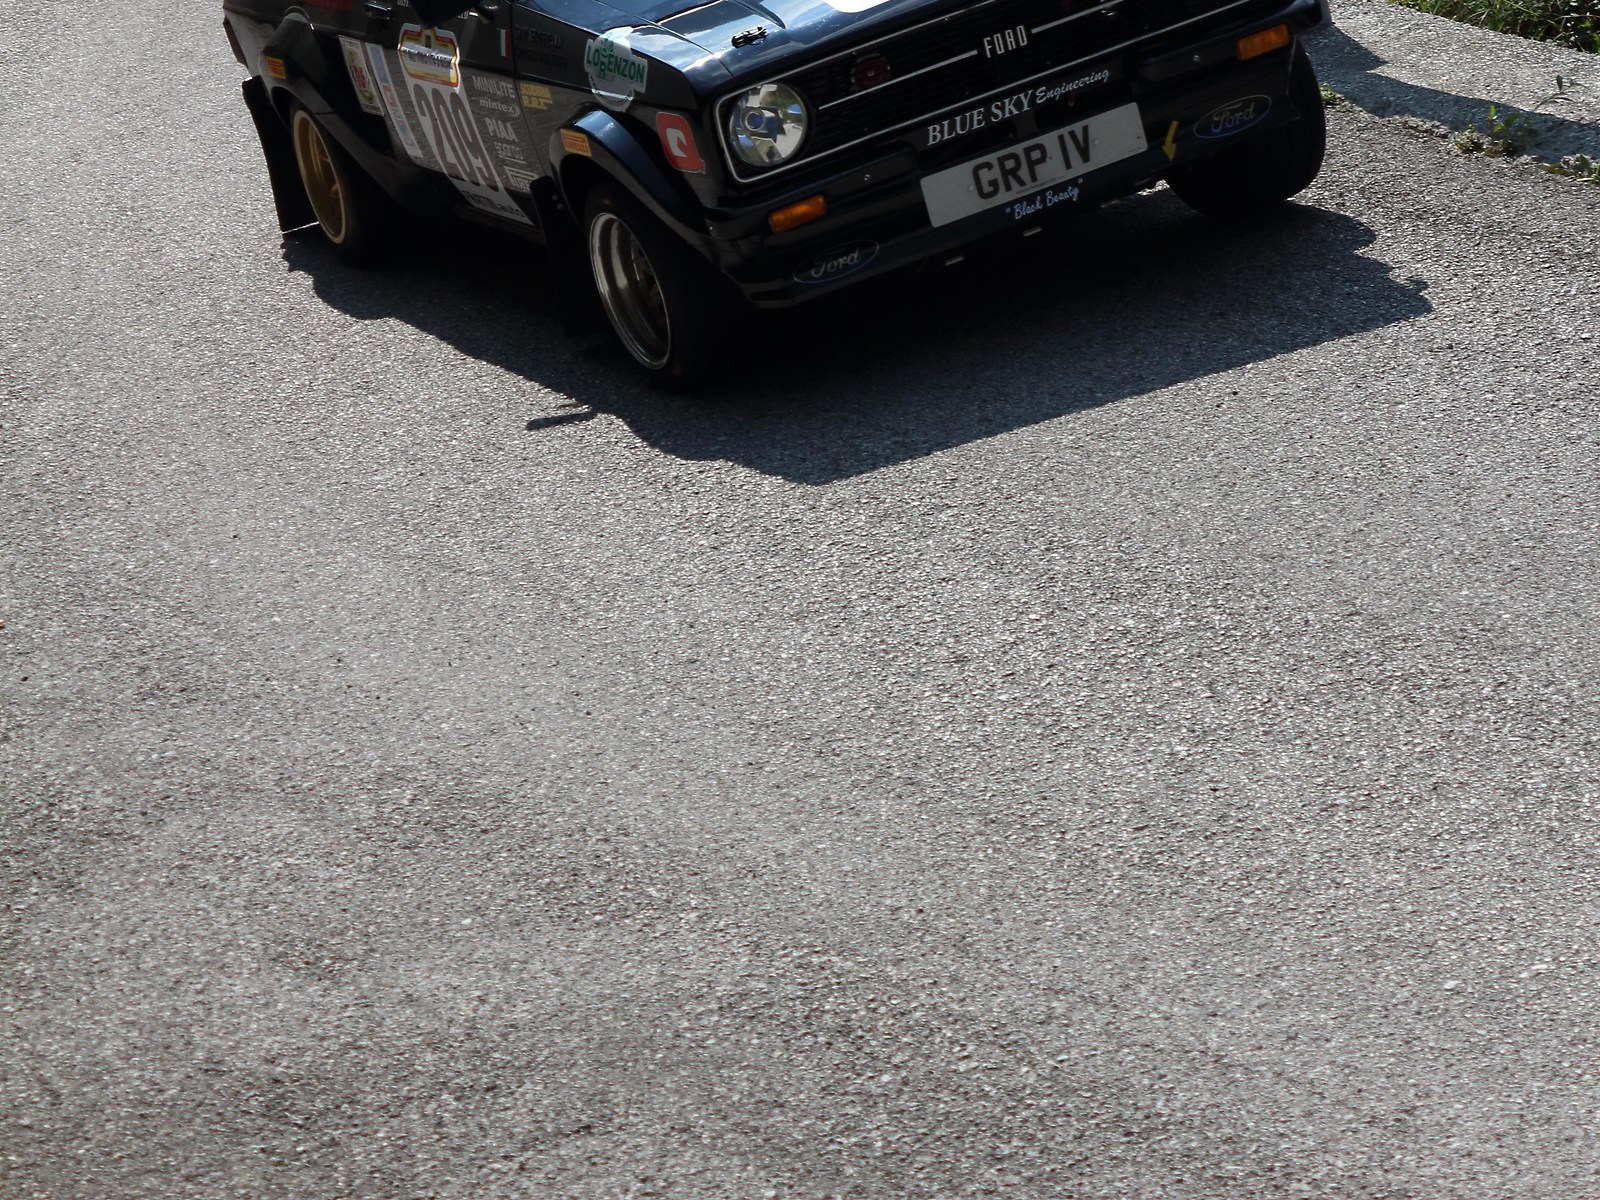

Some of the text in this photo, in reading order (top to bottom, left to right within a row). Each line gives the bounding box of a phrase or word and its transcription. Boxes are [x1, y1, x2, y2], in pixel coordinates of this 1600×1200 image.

[983, 26, 1028, 58] FORD
[926, 69, 1110, 147] BLUE SKY Engineering
[1210, 102, 1256, 132] Ford
[413, 84, 500, 192] 209
[971, 125, 1093, 201] GRP IV
[811, 246, 861, 278] Ford
